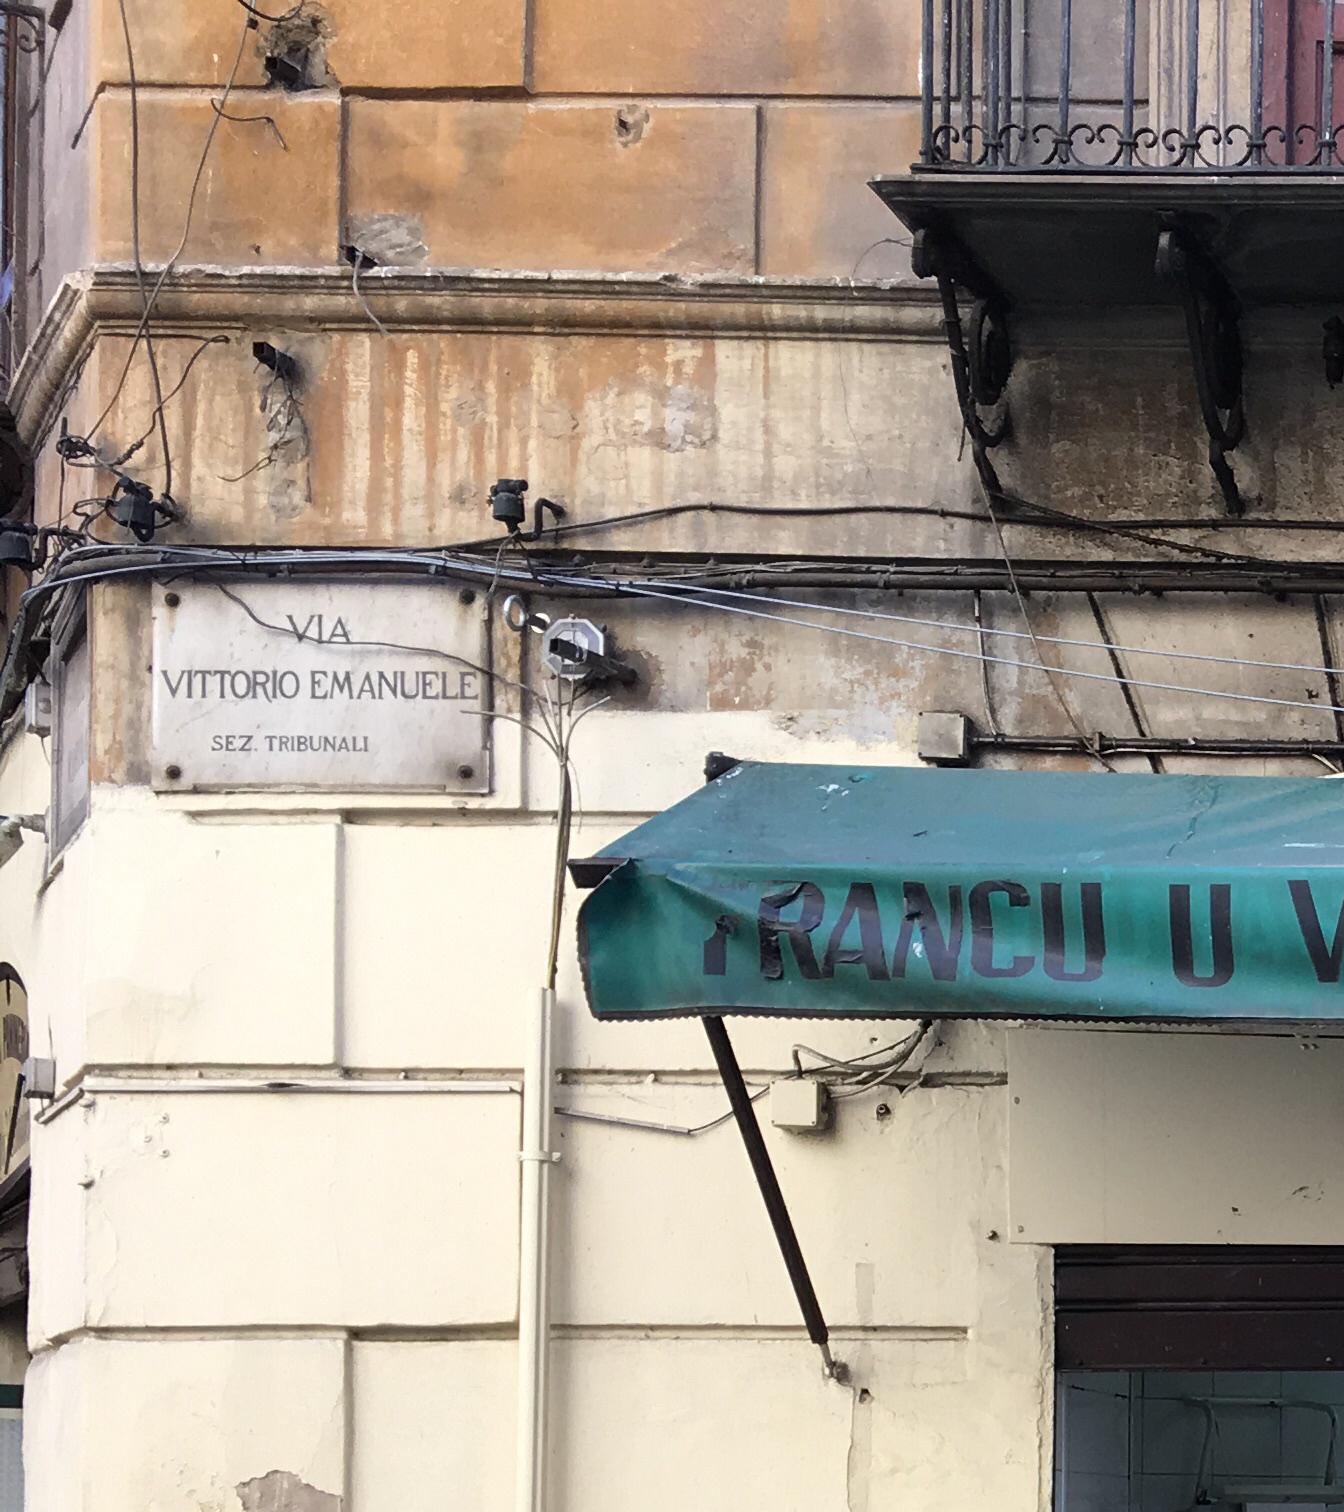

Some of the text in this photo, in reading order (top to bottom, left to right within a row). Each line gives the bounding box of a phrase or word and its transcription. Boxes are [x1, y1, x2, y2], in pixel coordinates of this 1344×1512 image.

[286, 615, 350, 643] VIA
[161, 670, 479, 703] VITTORIO EMANUELE
[211, 735, 369, 753] SEZ. TRIBUNALI
[1168, 883, 1234, 987] U
